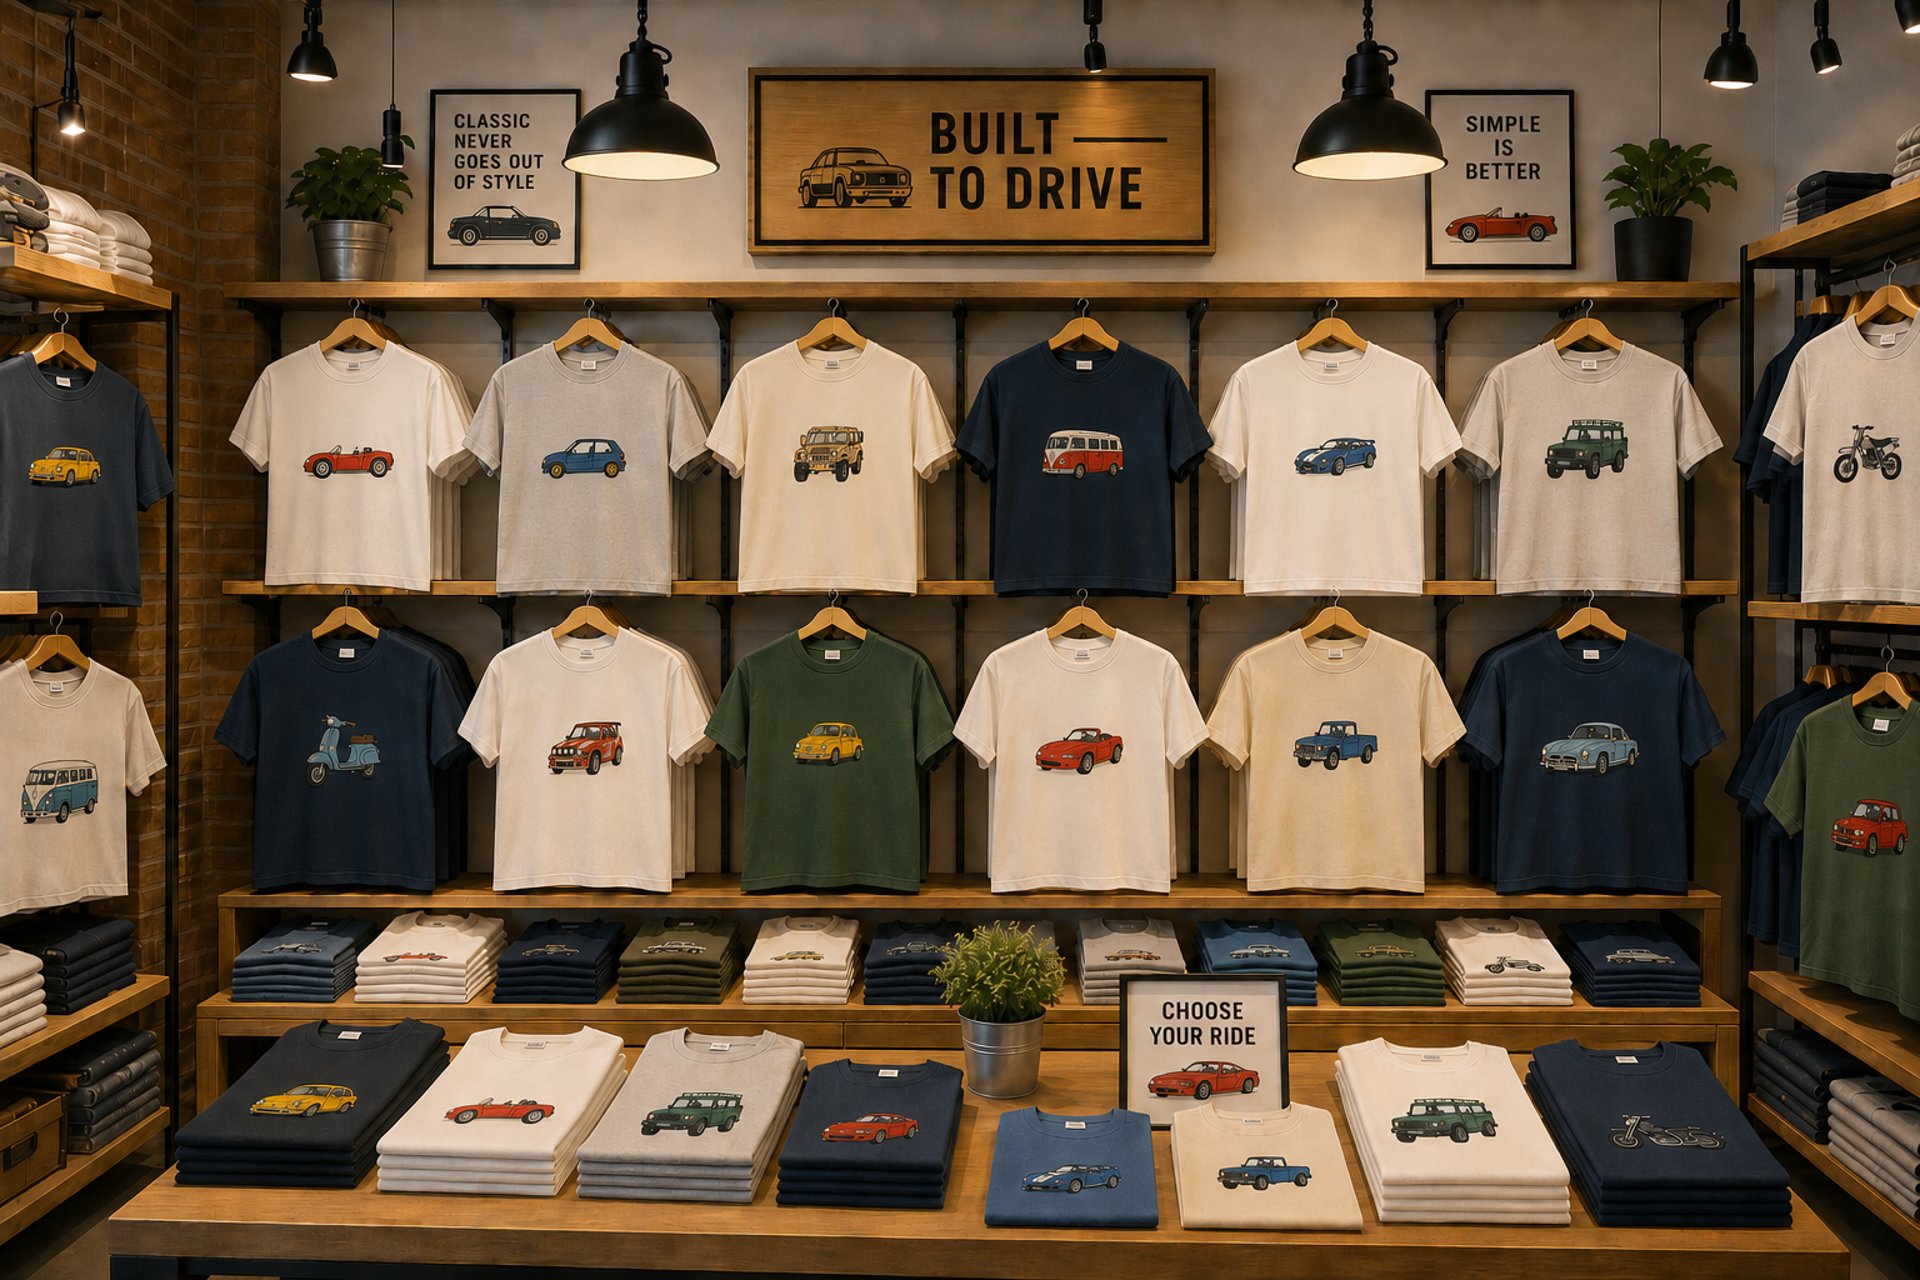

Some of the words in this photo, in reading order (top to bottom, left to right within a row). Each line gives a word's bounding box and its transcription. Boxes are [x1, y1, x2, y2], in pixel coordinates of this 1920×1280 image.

[455, 113, 530, 128] CLASSIC
[1466, 115, 1541, 132] SIMPLE
[454, 134, 511, 148] NEVER
[931, 112, 1059, 155] BUILT
[1494, 139, 1513, 156] IS
[454, 154, 501, 169] GOES
[509, 154, 544, 169] OUT
[1466, 163, 1541, 180] BETTER
[454, 174, 475, 189] OF
[483, 174, 535, 189] STYLE
[930, 167, 984, 209] TO
[1007, 167, 1142, 209] DRIVE
[1162, 1002, 1243, 1020] CHOOSE
[1150, 1027, 1203, 1045] YOUR
[1211, 1027, 1256, 1045] RIDE
